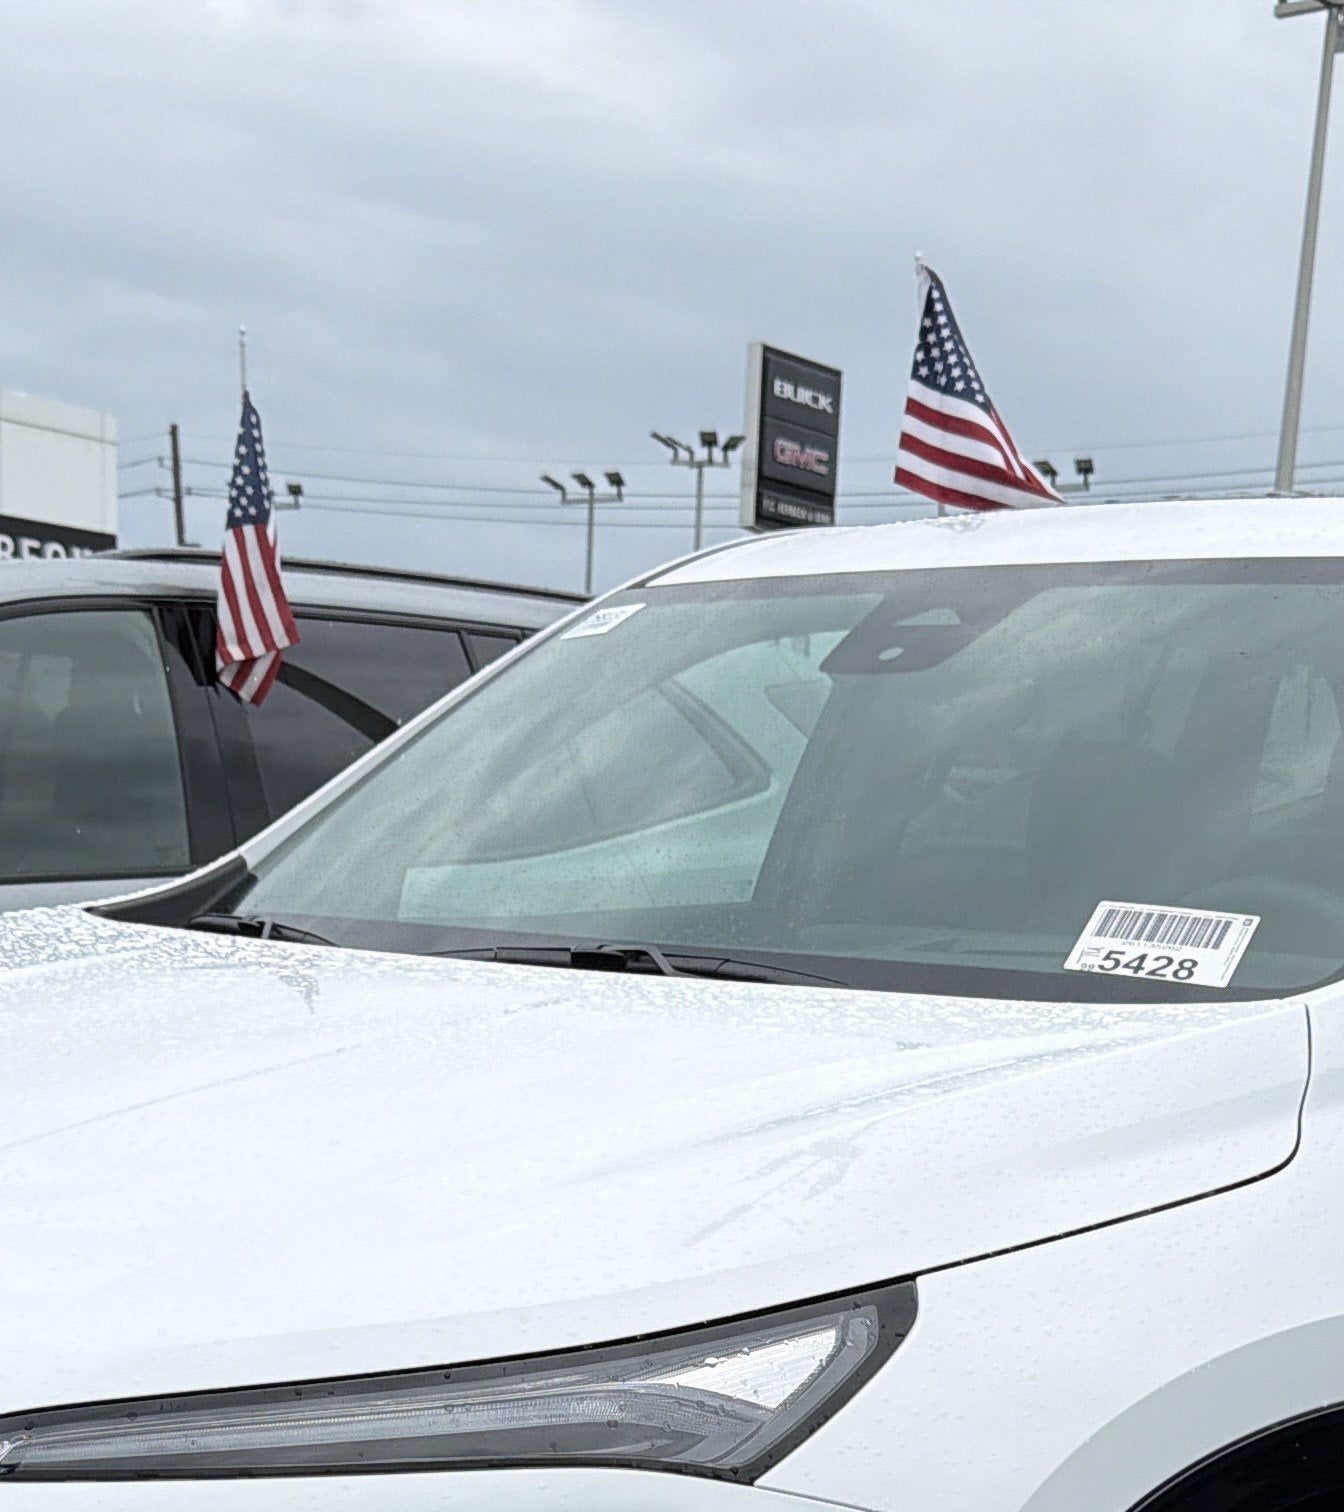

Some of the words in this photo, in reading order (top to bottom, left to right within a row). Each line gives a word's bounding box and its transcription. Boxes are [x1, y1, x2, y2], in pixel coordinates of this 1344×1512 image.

[773, 377, 834, 414] BUICK
[773, 437, 830, 475] GMC
[1097, 949, 1199, 981] 5428
